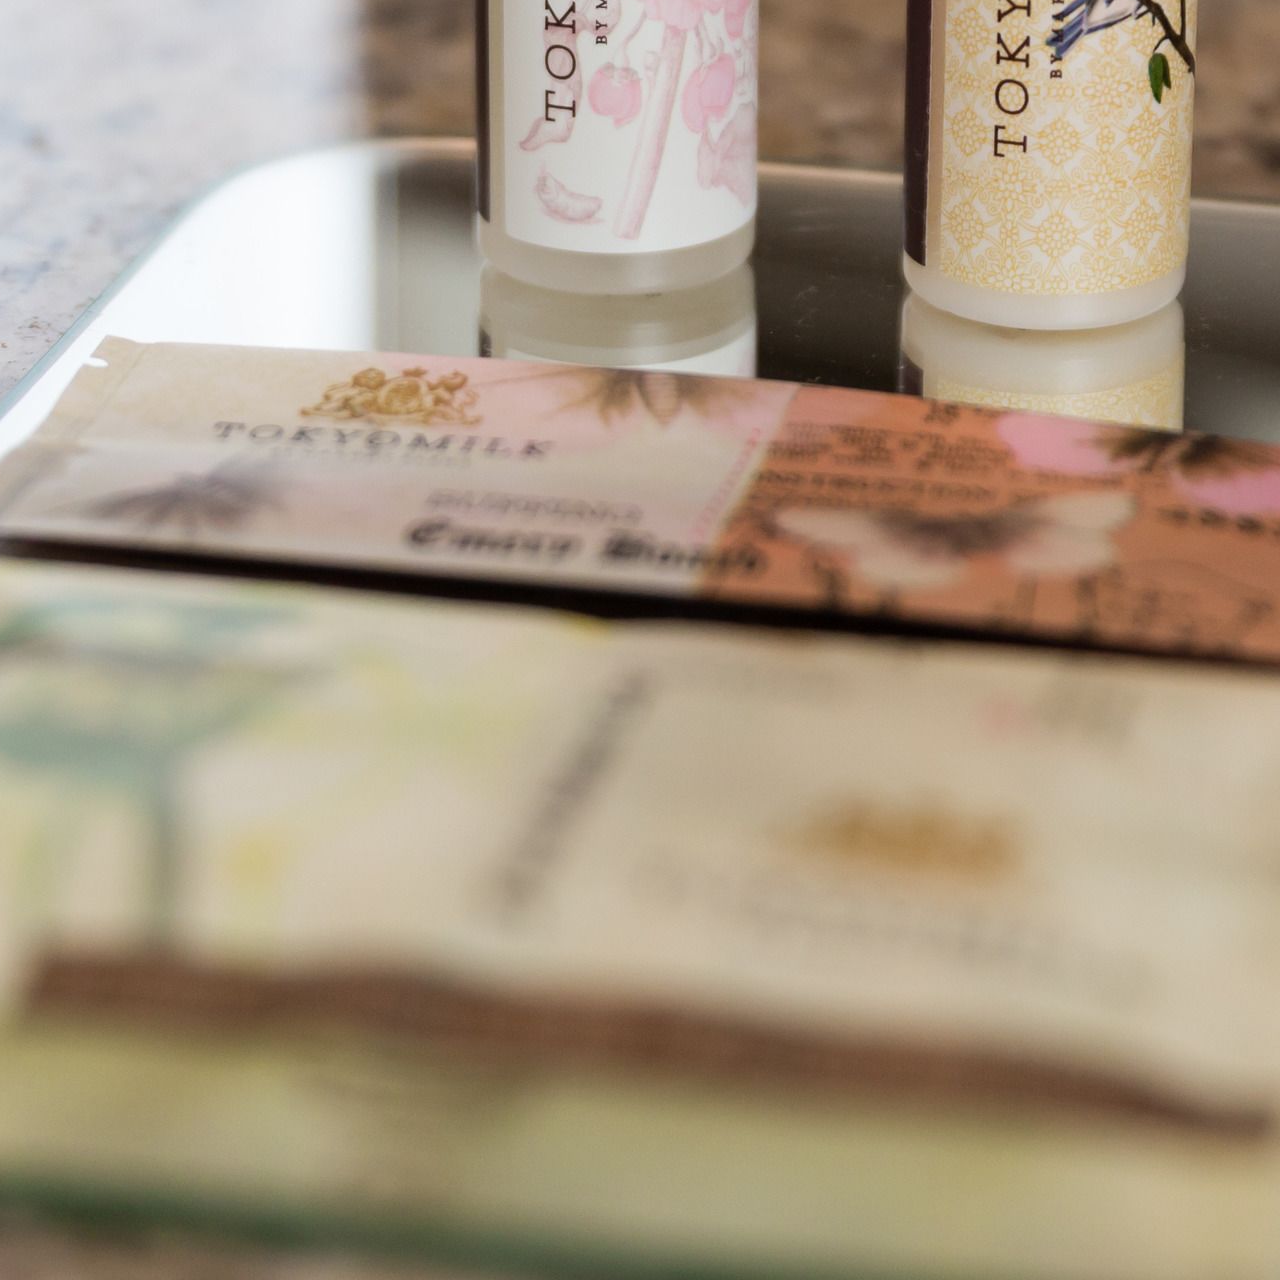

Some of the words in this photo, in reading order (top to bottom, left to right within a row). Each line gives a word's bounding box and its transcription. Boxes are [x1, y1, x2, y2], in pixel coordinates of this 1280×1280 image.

[595, 19, 609, 45] BY
[1049, 52, 1064, 79] BY
[213, 420, 557, 460] TOKYOMILK
